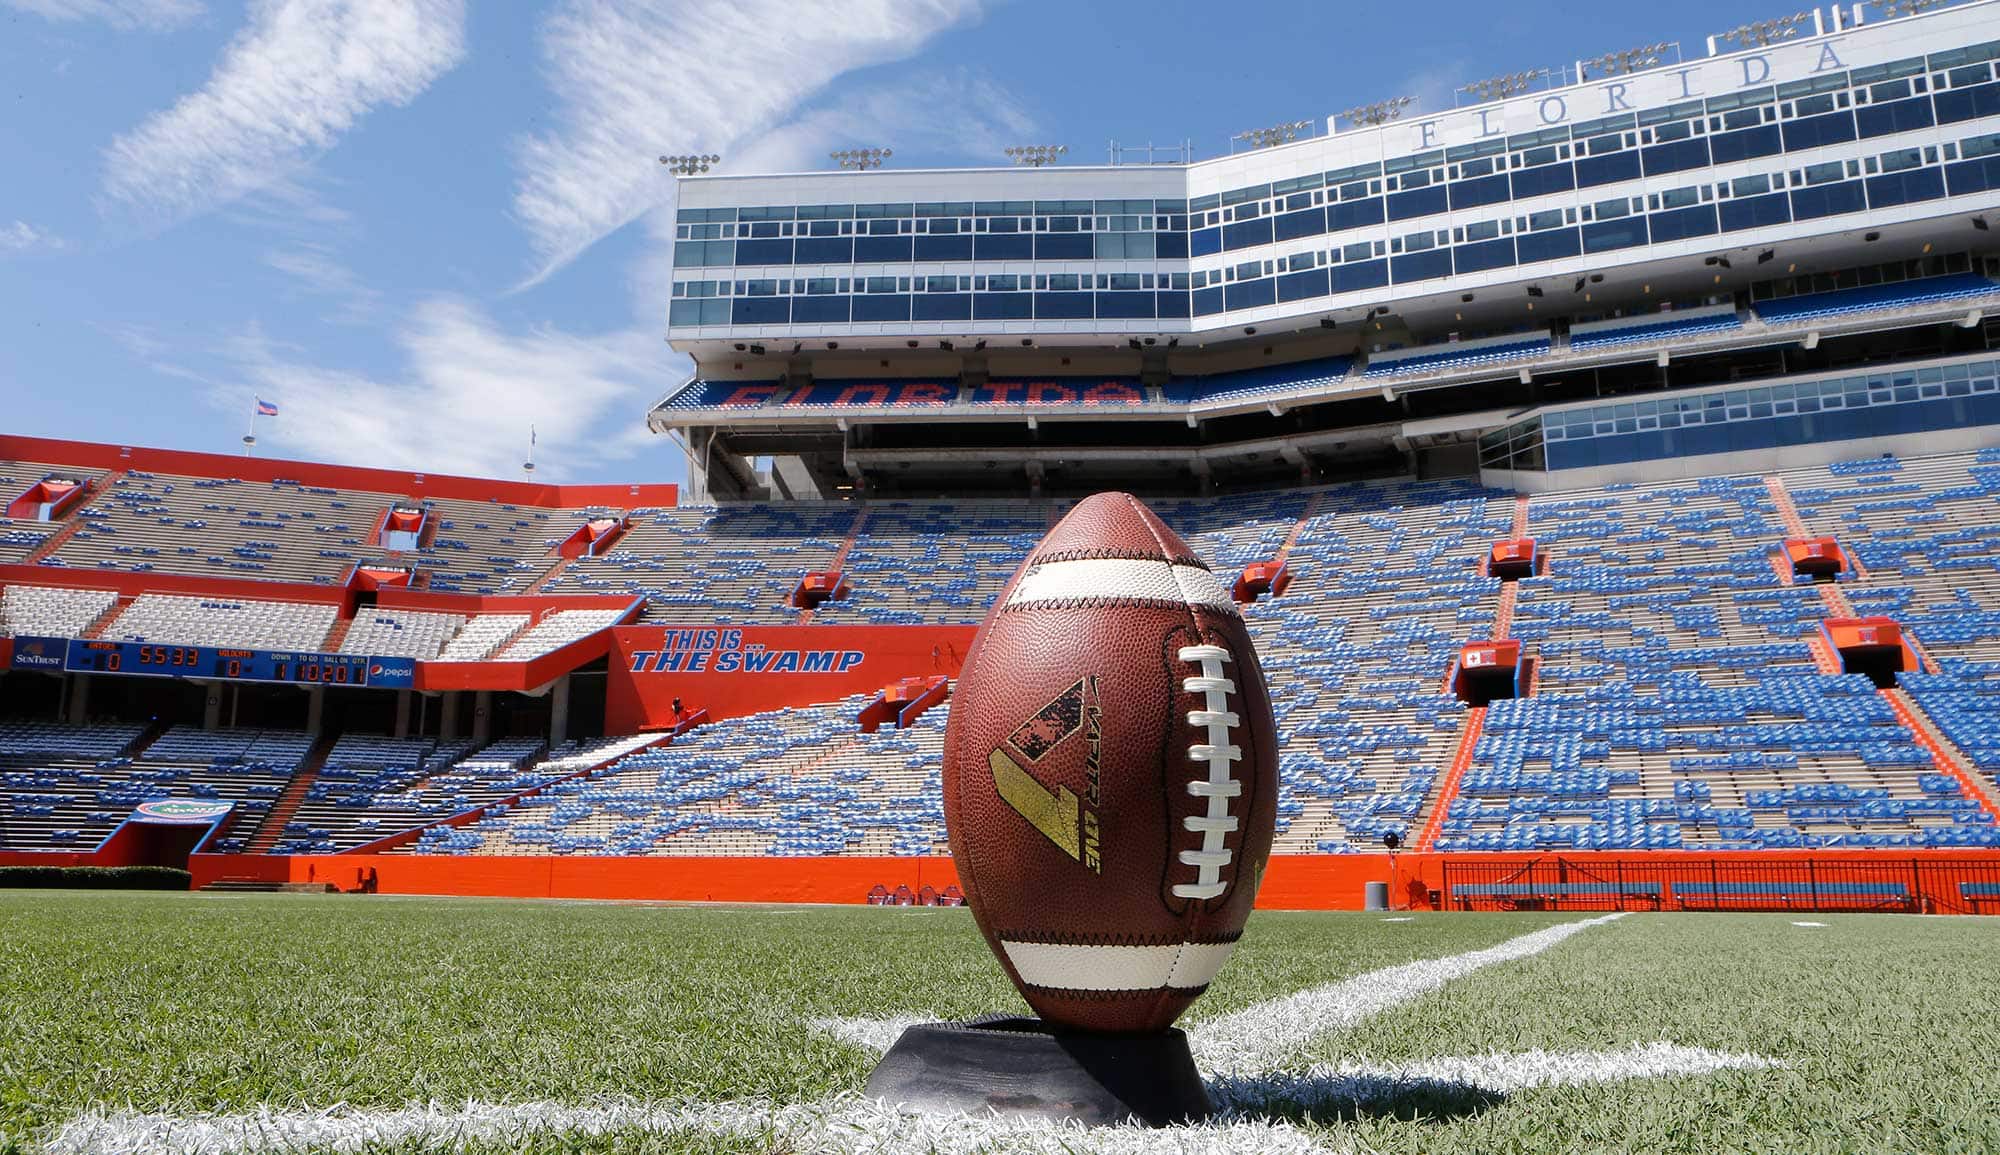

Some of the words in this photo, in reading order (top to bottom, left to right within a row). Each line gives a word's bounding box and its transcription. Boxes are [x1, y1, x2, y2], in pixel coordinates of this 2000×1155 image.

[1411, 37, 1849, 150] FLORIDA
[664, 629, 718, 651] THIS
[108, 653, 121, 671] 0
[140, 647, 200, 667] 55:33
[271, 653, 292, 661] DOWN
[630, 650, 713, 673] THE
[714, 650, 865, 673] SWAMP
[228, 660, 241, 677] 0
[322, 665, 347, 682] 20
[384, 668, 412, 677] pepsi
